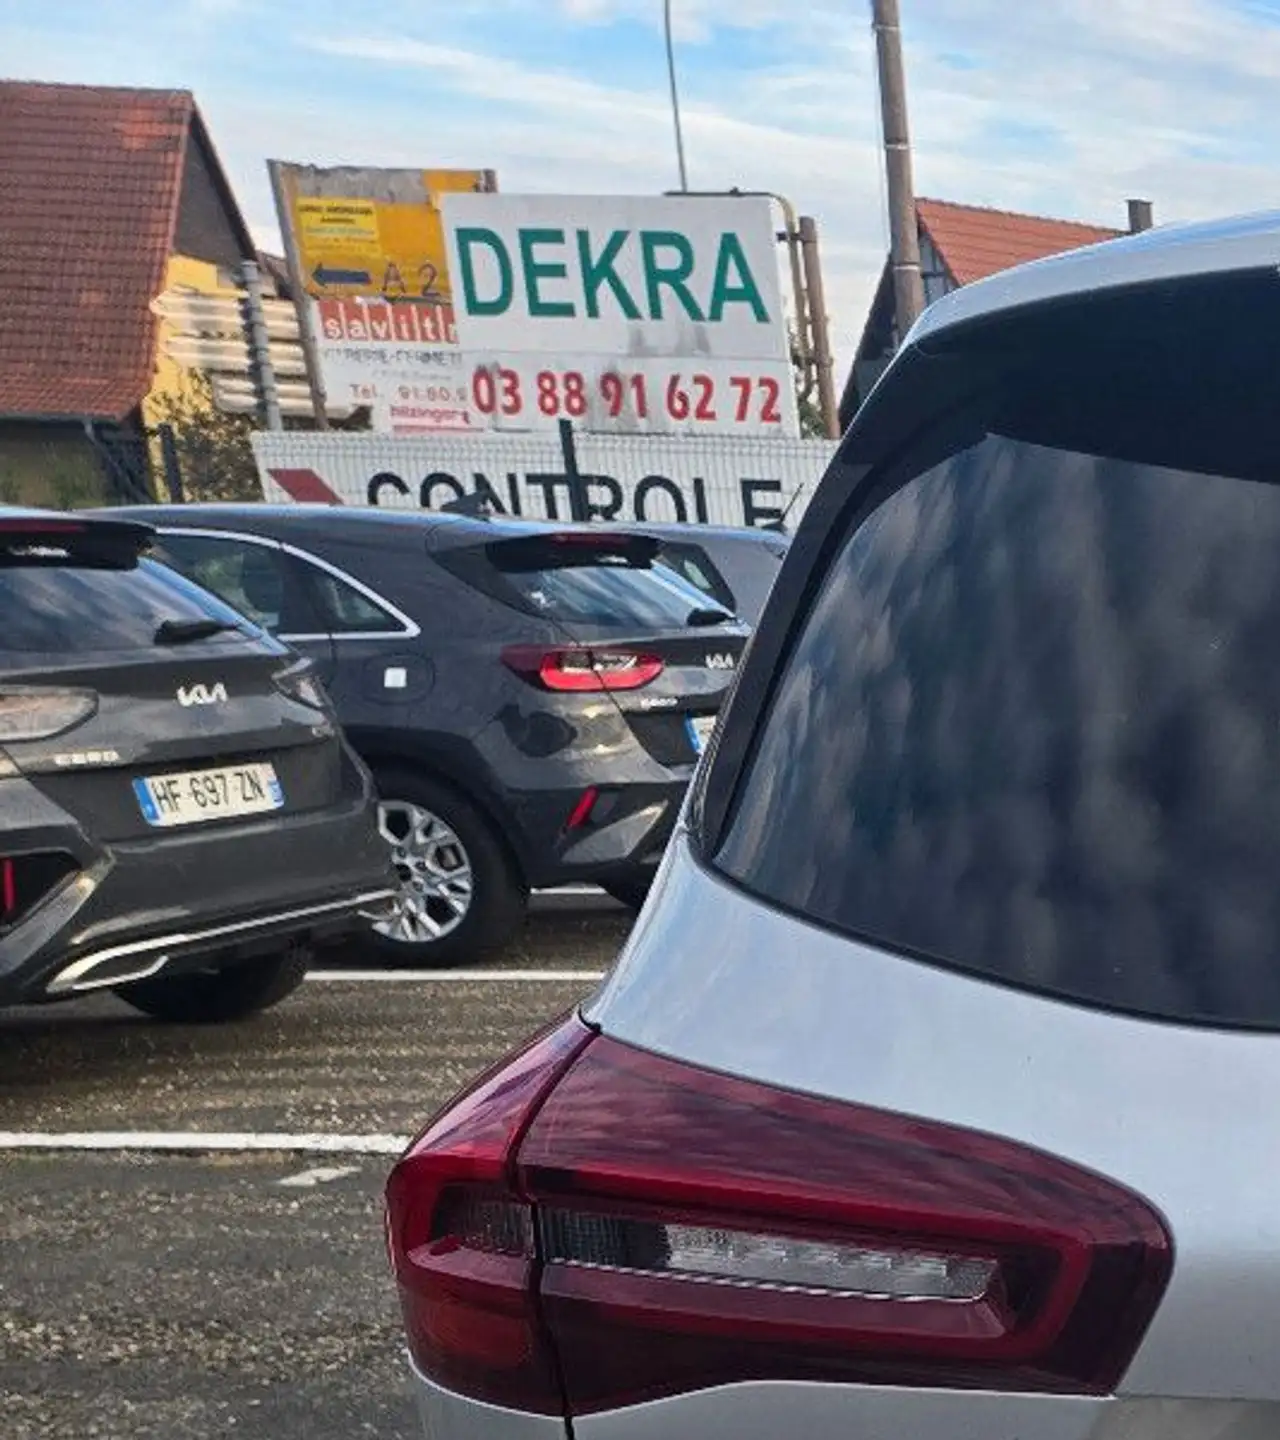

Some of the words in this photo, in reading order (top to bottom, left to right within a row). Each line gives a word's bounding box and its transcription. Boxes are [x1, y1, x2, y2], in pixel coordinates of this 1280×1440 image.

[382, 262, 406, 293] A
[419, 262, 441, 297] 2
[454, 228, 770, 324] DEKRA
[472, 364, 524, 415] 03
[536, 369, 588, 417] 88
[600, 370, 648, 419] 91
[666, 373, 718, 422] 62
[729, 376, 782, 424] 72
